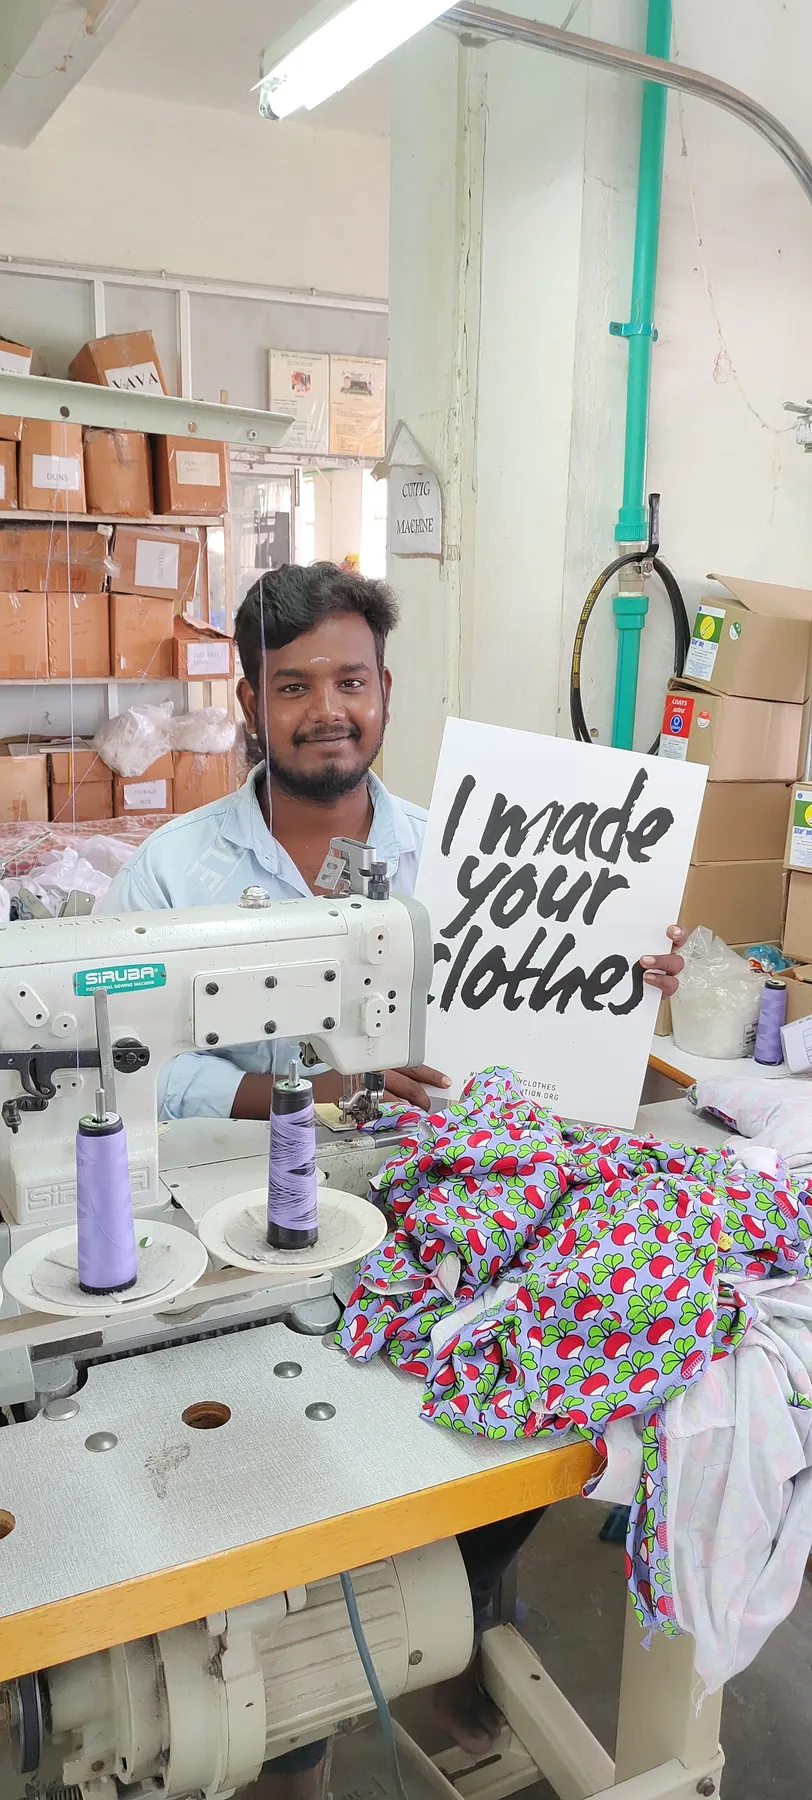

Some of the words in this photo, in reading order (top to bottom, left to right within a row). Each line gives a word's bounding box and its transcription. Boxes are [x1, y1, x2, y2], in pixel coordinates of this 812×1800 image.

[112, 372, 159, 389] VAVA
[46, 472, 69, 482] DUNS
[396, 517, 434, 534] MACHINE
[441, 774, 476, 857] I
[480, 767, 675, 864] made
[440, 855, 631, 938] your
